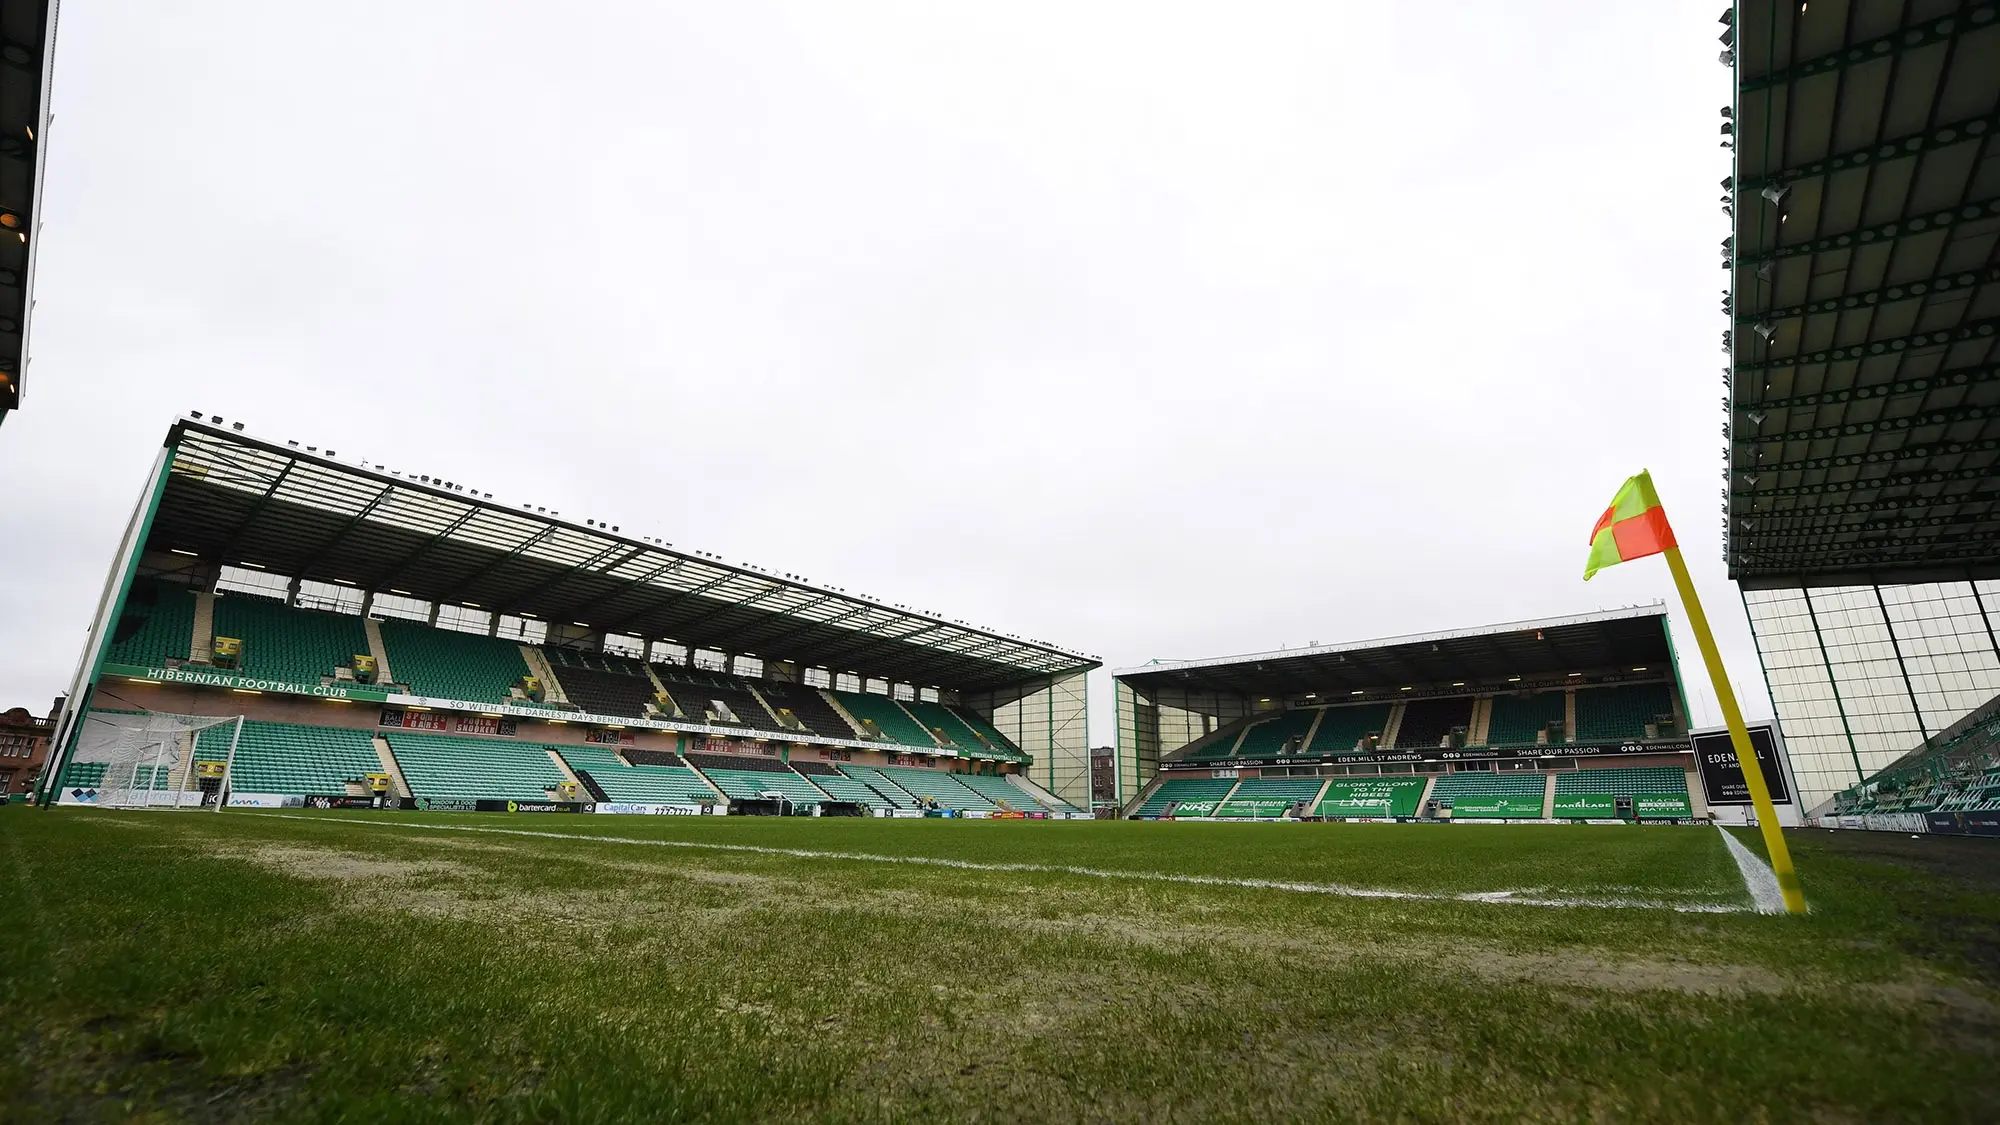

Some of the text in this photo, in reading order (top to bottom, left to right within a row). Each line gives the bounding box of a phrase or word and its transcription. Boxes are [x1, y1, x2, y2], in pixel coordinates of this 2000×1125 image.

[147, 668, 348, 698] HIBERNIAN FOOTBALL CLUB
[405, 711, 446, 722] SPORTS
[449, 700, 464, 709] SO
[468, 702, 497, 712] WITH
[502, 705, 523, 715] THE
[525, 707, 568, 719] DARKEST
[571, 712, 594, 722] DAYS
[596, 714, 630, 725] BEHIND
[632, 717, 650, 727] OUR
[652, 719, 672, 729] SHIP
[673, 721, 685, 730] OF
[686, 722, 705, 732] HOPE
[709, 725, 727, 734] WILL
[411, 720, 439, 729] BARS
[456, 724, 496, 734] SNOOKER
[1516, 748, 1543, 756] SHARE
[1564, 746, 1600, 755] PASSION
[1646, 743, 1691, 751] EDENMILL.COM
[604, 803, 630, 812] Capital
